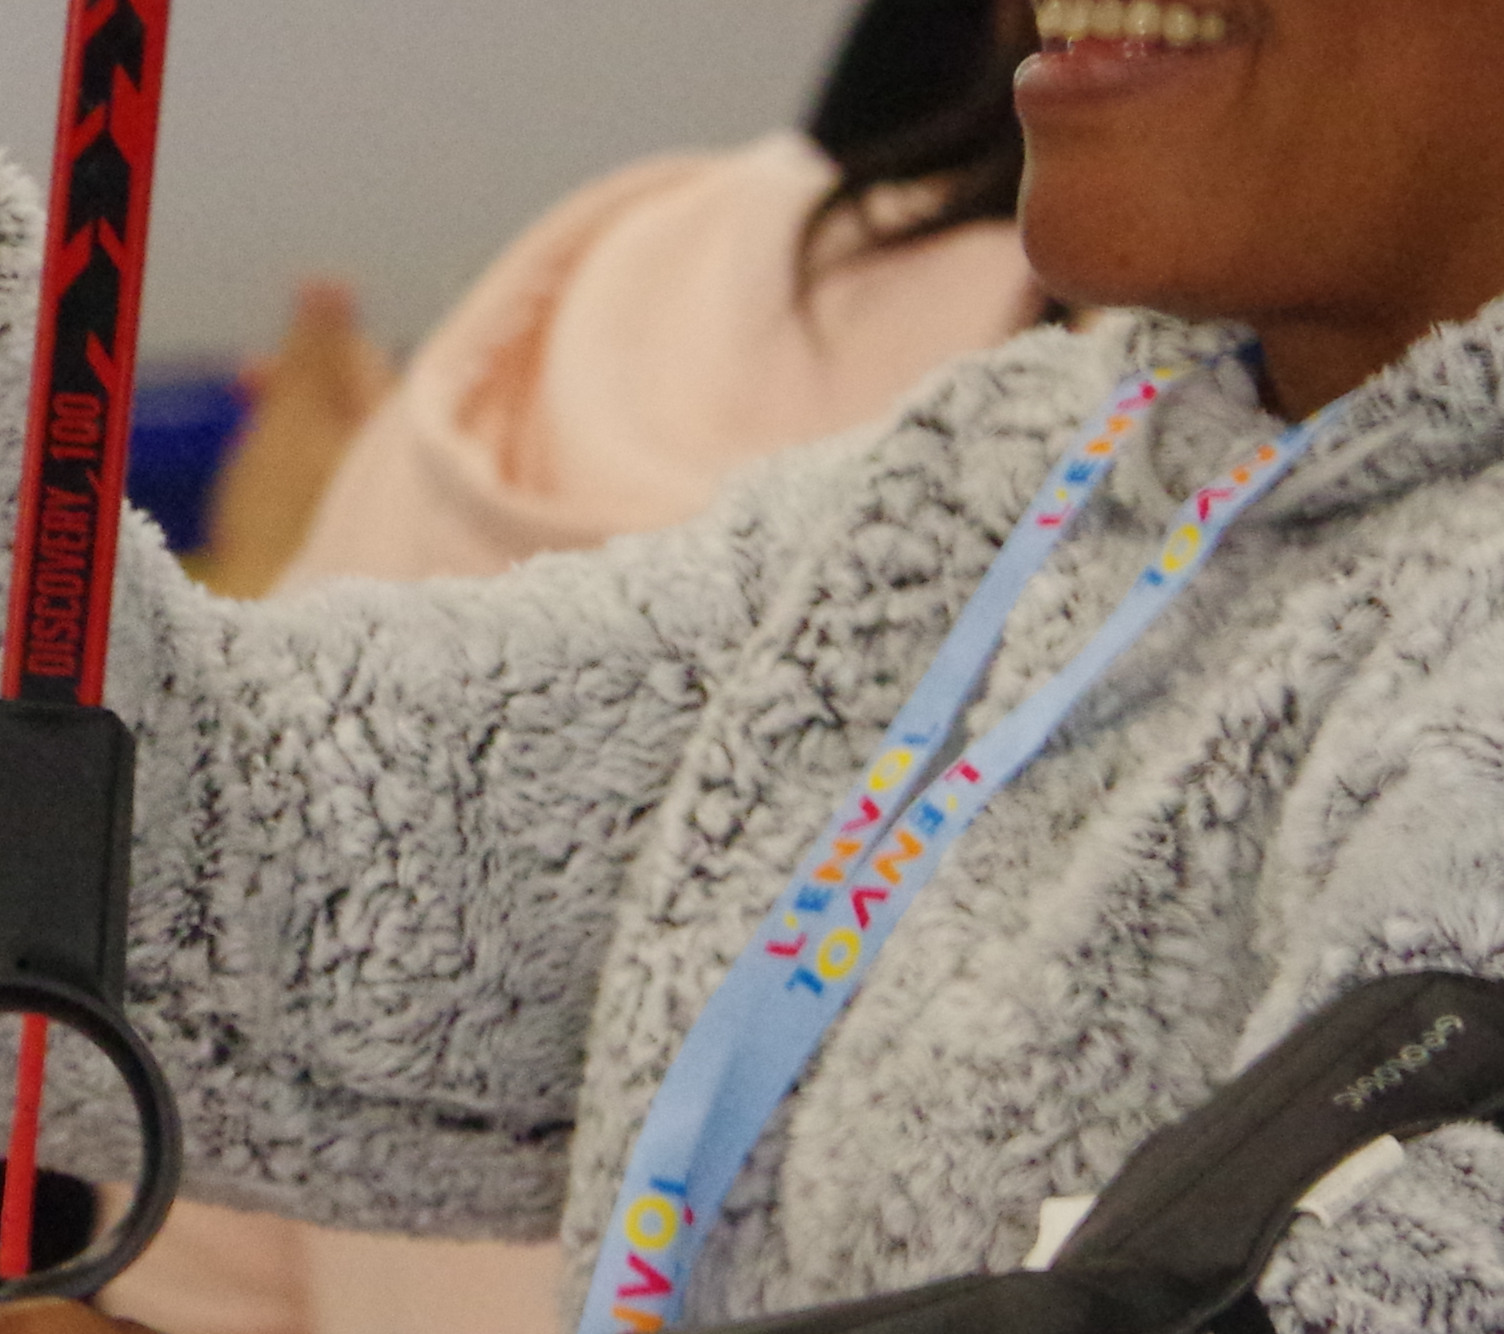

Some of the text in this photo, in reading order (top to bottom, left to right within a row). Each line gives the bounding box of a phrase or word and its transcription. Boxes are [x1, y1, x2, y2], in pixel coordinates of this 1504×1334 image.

[26, 393, 101, 676] DISCOVERY 100
[765, 723, 940, 958] L'ENVOL
[785, 760, 982, 997] L'ENVOL
